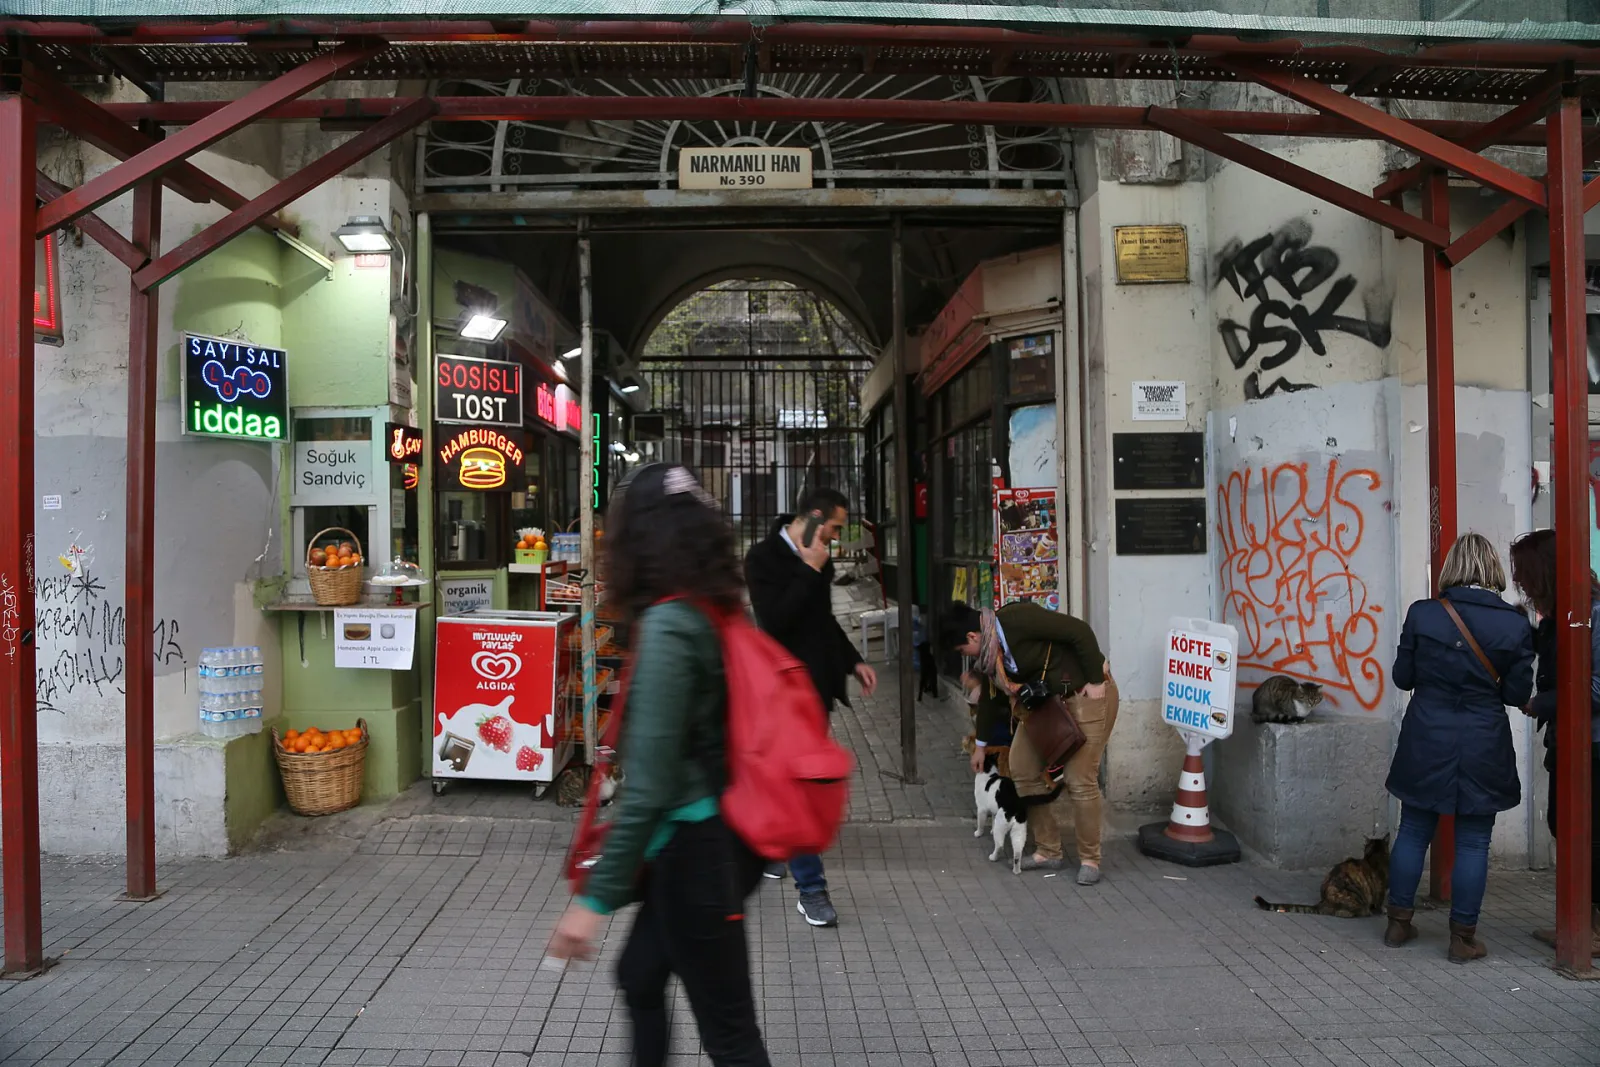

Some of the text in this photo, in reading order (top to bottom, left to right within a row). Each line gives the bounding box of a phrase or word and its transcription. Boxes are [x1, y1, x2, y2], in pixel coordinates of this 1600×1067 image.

[690, 154, 801, 172] NARMANLI HAN
[720, 175, 765, 186] No 390
[192, 338, 280, 368] SAYISAL
[210, 366, 266, 396] LOTO
[439, 361, 519, 395] SOSİSLİ
[194, 400, 281, 437] iddaa
[452, 393, 508, 421] TOST
[306, 449, 356, 467] Soğuk
[440, 428, 523, 466] HAMBURGER
[303, 471, 365, 488] Sandviç
[446, 583, 487, 598] organik
[1171, 633, 1212, 658] KÖFTE
[1168, 658, 1212, 682] EKMEK
[476, 682, 515, 691] ALGIDA
[1167, 681, 1211, 706] SUCUK
[1166, 704, 1210, 730] EKMEK
